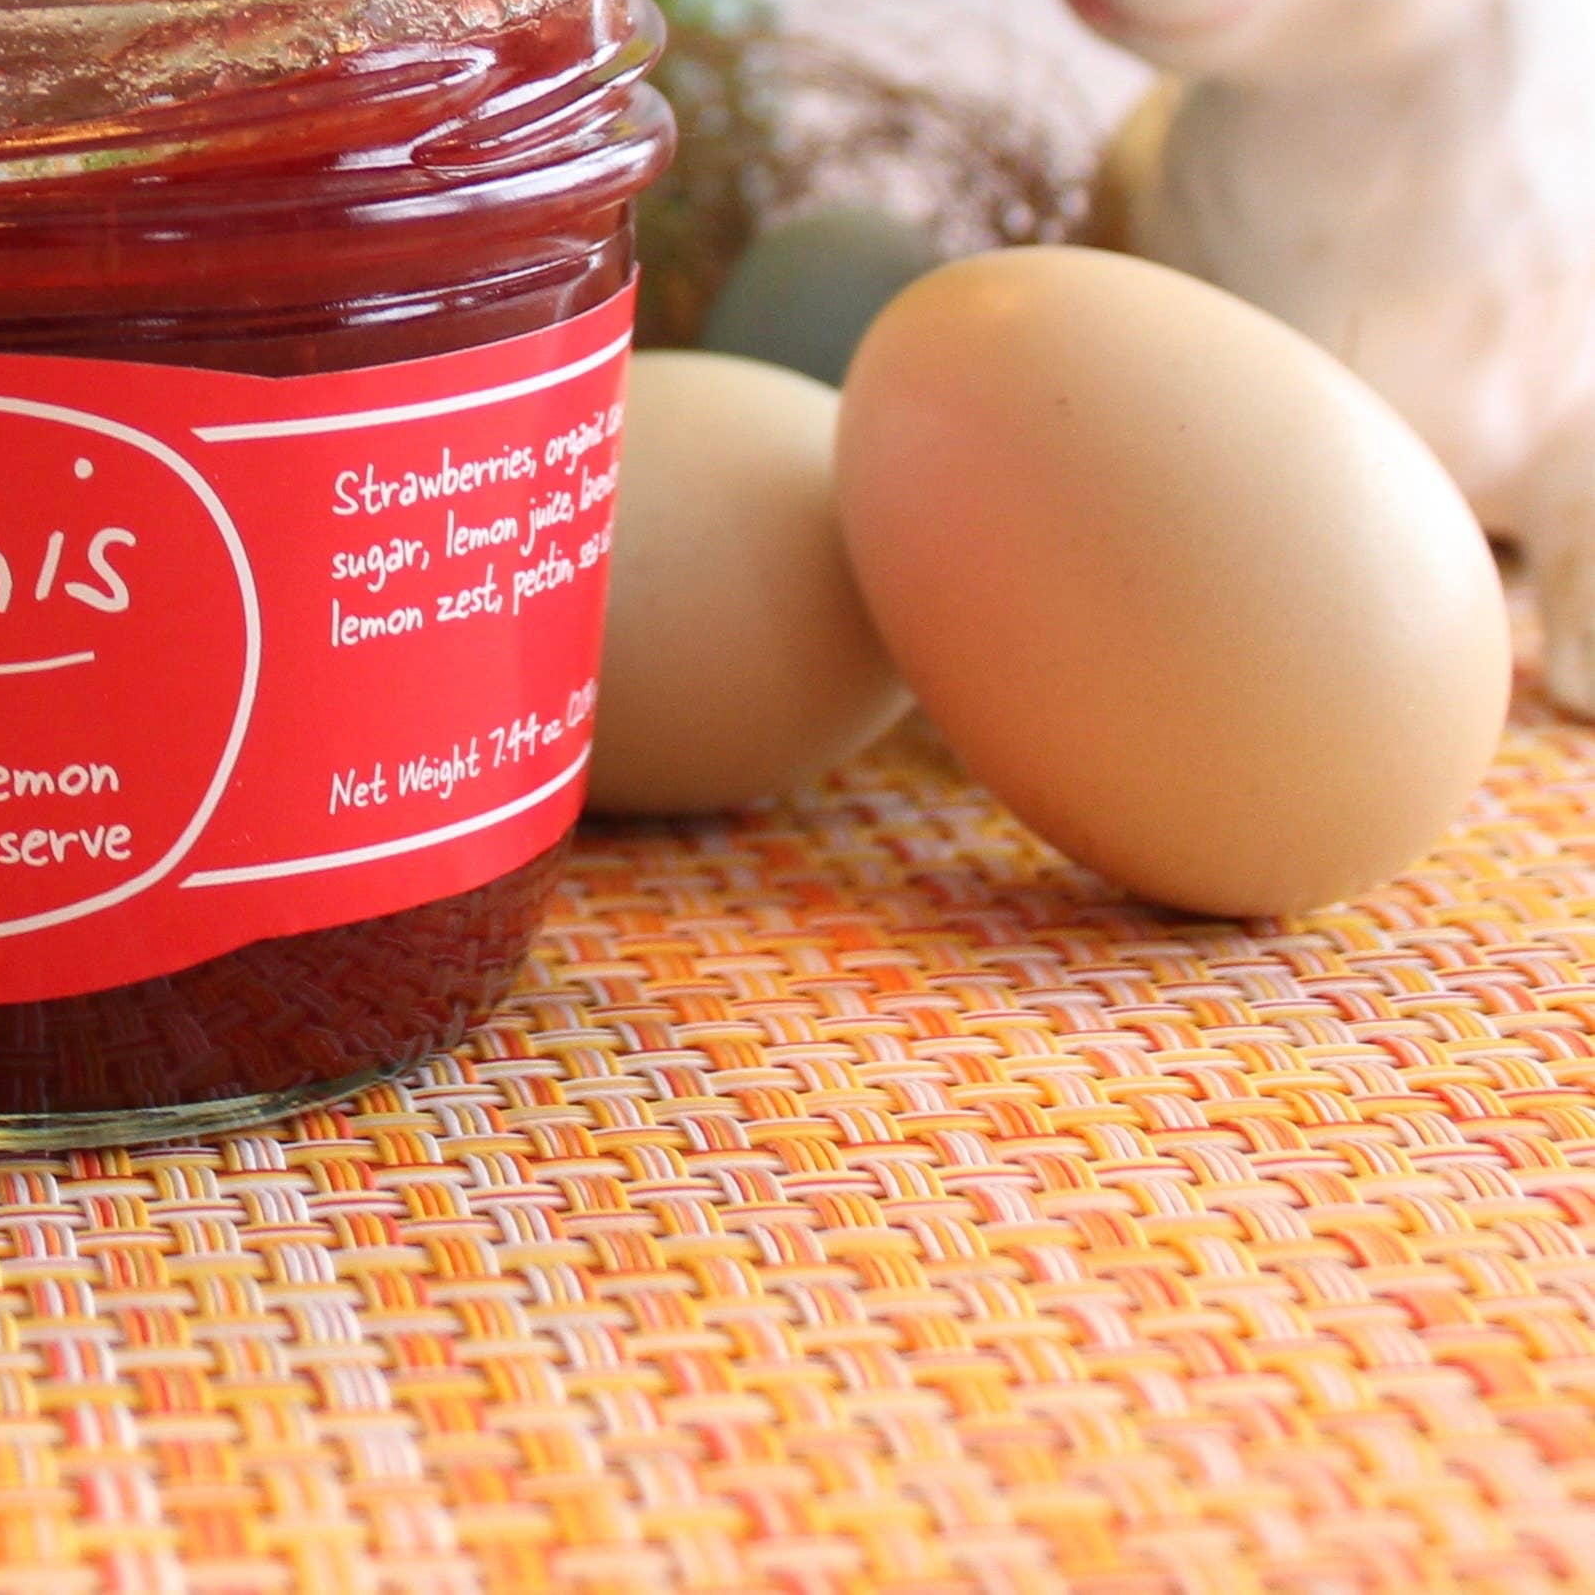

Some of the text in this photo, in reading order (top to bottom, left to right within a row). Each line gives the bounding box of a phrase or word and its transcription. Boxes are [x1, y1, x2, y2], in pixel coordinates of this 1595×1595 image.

[331, 446, 539, 516] Strawberries,
[330, 597, 424, 648] lemon
[436, 560, 507, 624] zest,
[512, 540, 575, 617] pectin,
[331, 536, 432, 594] sugar,
[444, 508, 522, 560] lemon
[518, 491, 575, 558] juice,
[328, 761, 389, 816] Net
[398, 734, 484, 801] Weight
[487, 710, 542, 770] 7.44
